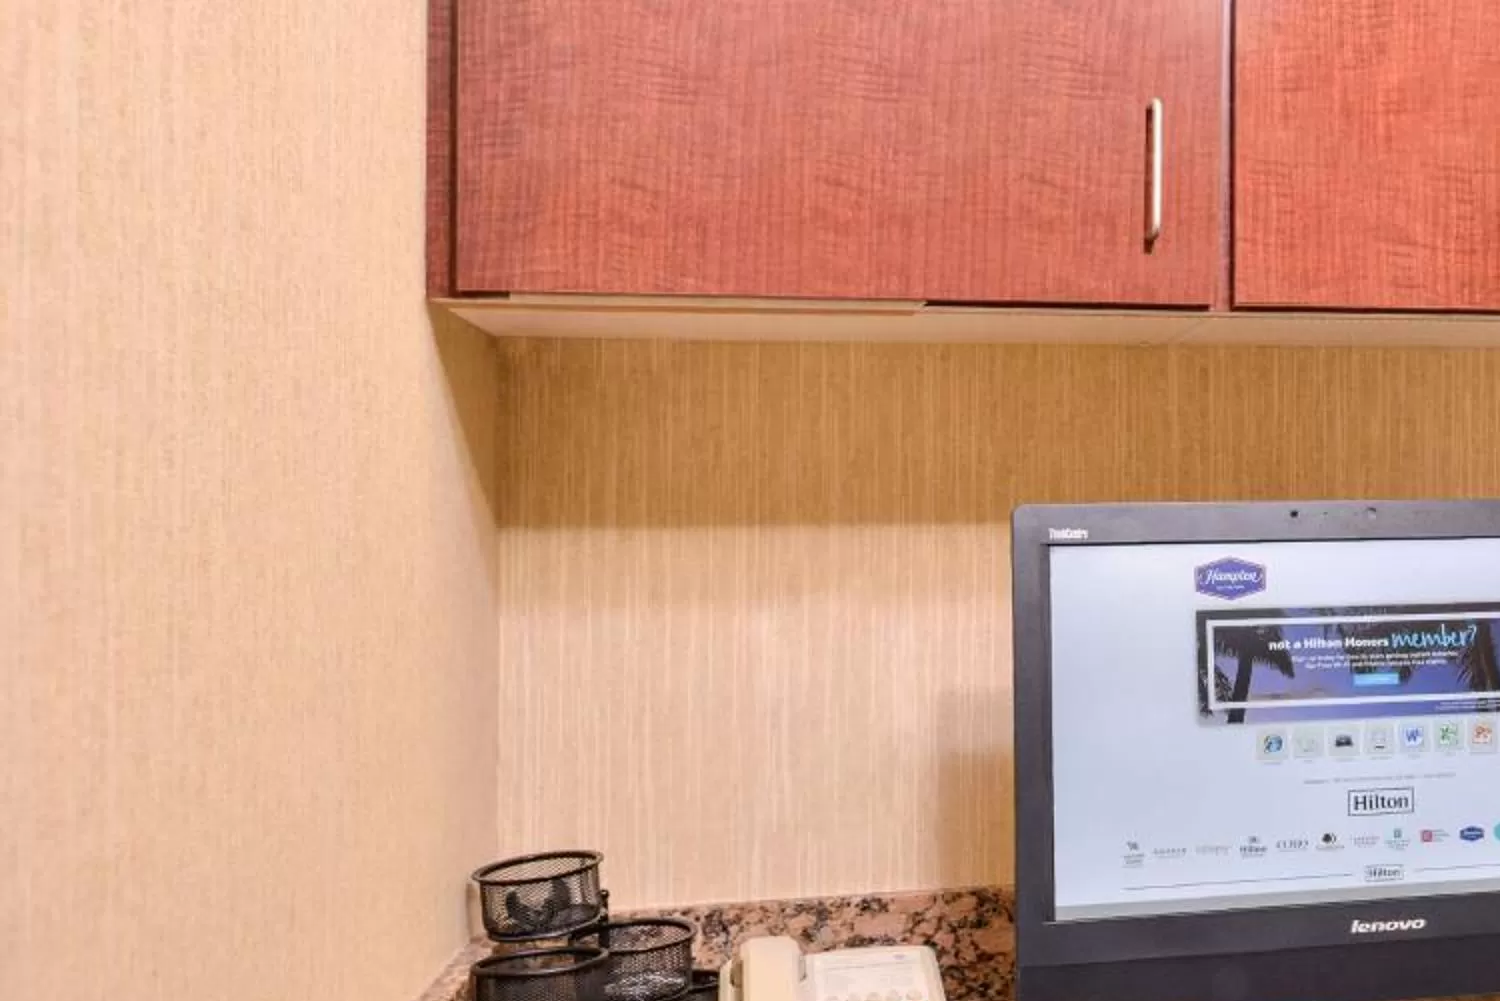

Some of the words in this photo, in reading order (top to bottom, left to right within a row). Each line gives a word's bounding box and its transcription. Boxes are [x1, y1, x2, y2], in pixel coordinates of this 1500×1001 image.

[1205, 567, 1258, 584] Hampton
[1269, 641, 1292, 650] not
[1304, 638, 1342, 648] Hilton
[1345, 636, 1389, 647] Honors
[1391, 623, 1477, 648] member?
[1353, 794, 1409, 811] Hilton
[1351, 918, 1427, 934] lenovo
